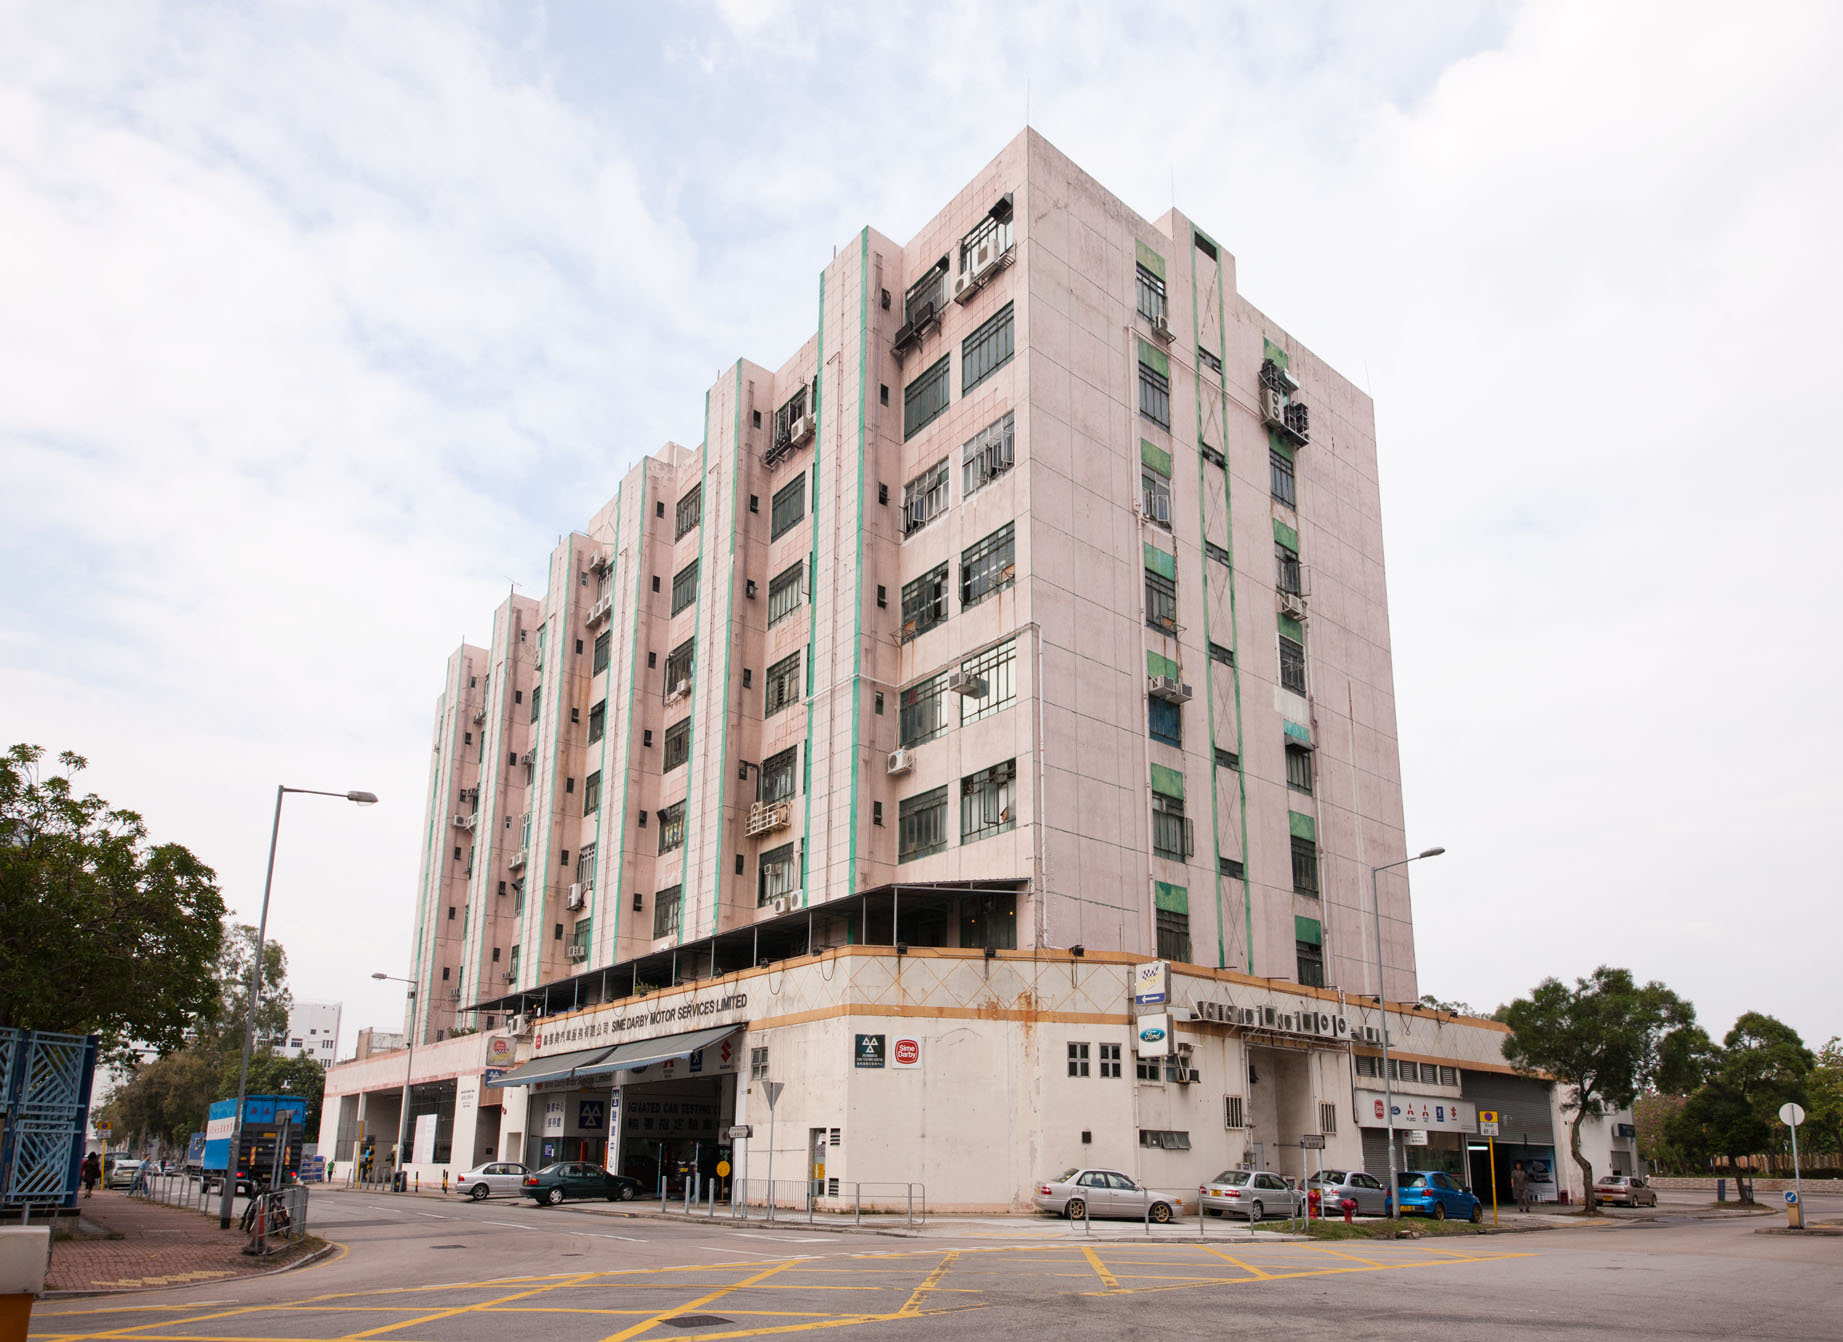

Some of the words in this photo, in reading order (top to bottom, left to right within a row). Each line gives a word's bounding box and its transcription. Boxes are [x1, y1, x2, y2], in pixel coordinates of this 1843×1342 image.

[611, 1017, 626, 1033] SIME
[626, 1013, 649, 1030] DARBY
[649, 1007, 677, 1025] MOTOR
[677, 999, 715, 1021] SERVICES
[716, 993, 748, 1013] LIMITED
[1144, 1030, 1161, 1041] Ford
[899, 1044, 915, 1052] Sime
[898, 1051, 916, 1059] Darby
